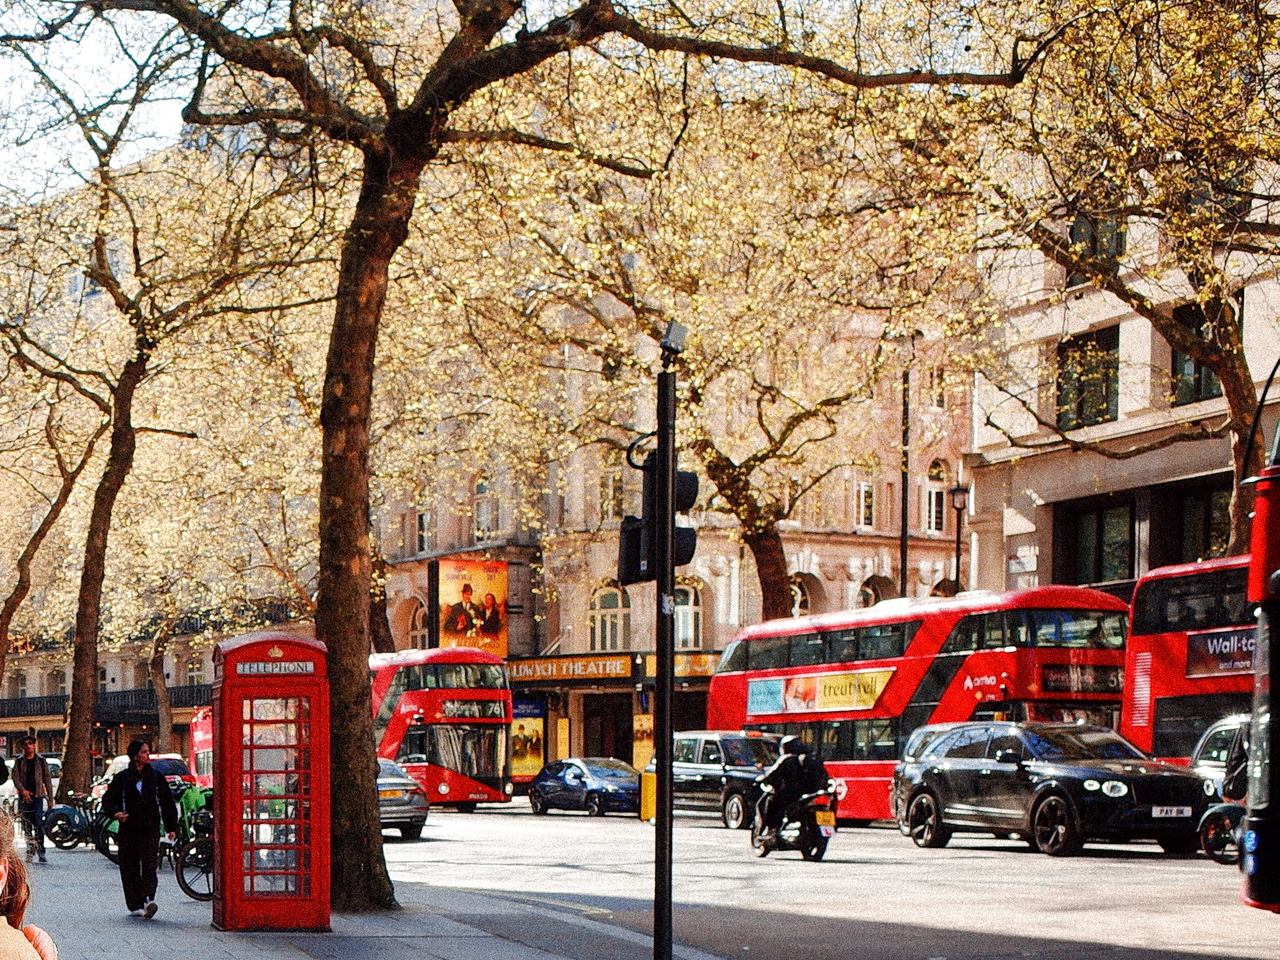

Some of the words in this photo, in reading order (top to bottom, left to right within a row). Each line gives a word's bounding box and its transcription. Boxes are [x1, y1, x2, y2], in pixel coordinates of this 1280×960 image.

[239, 662, 311, 674] TELEPHONE
[561, 660, 625, 676] THEATRE
[1219, 660, 1233, 669] and
[1233, 659, 1251, 668] more
[488, 702, 501, 716] 76
